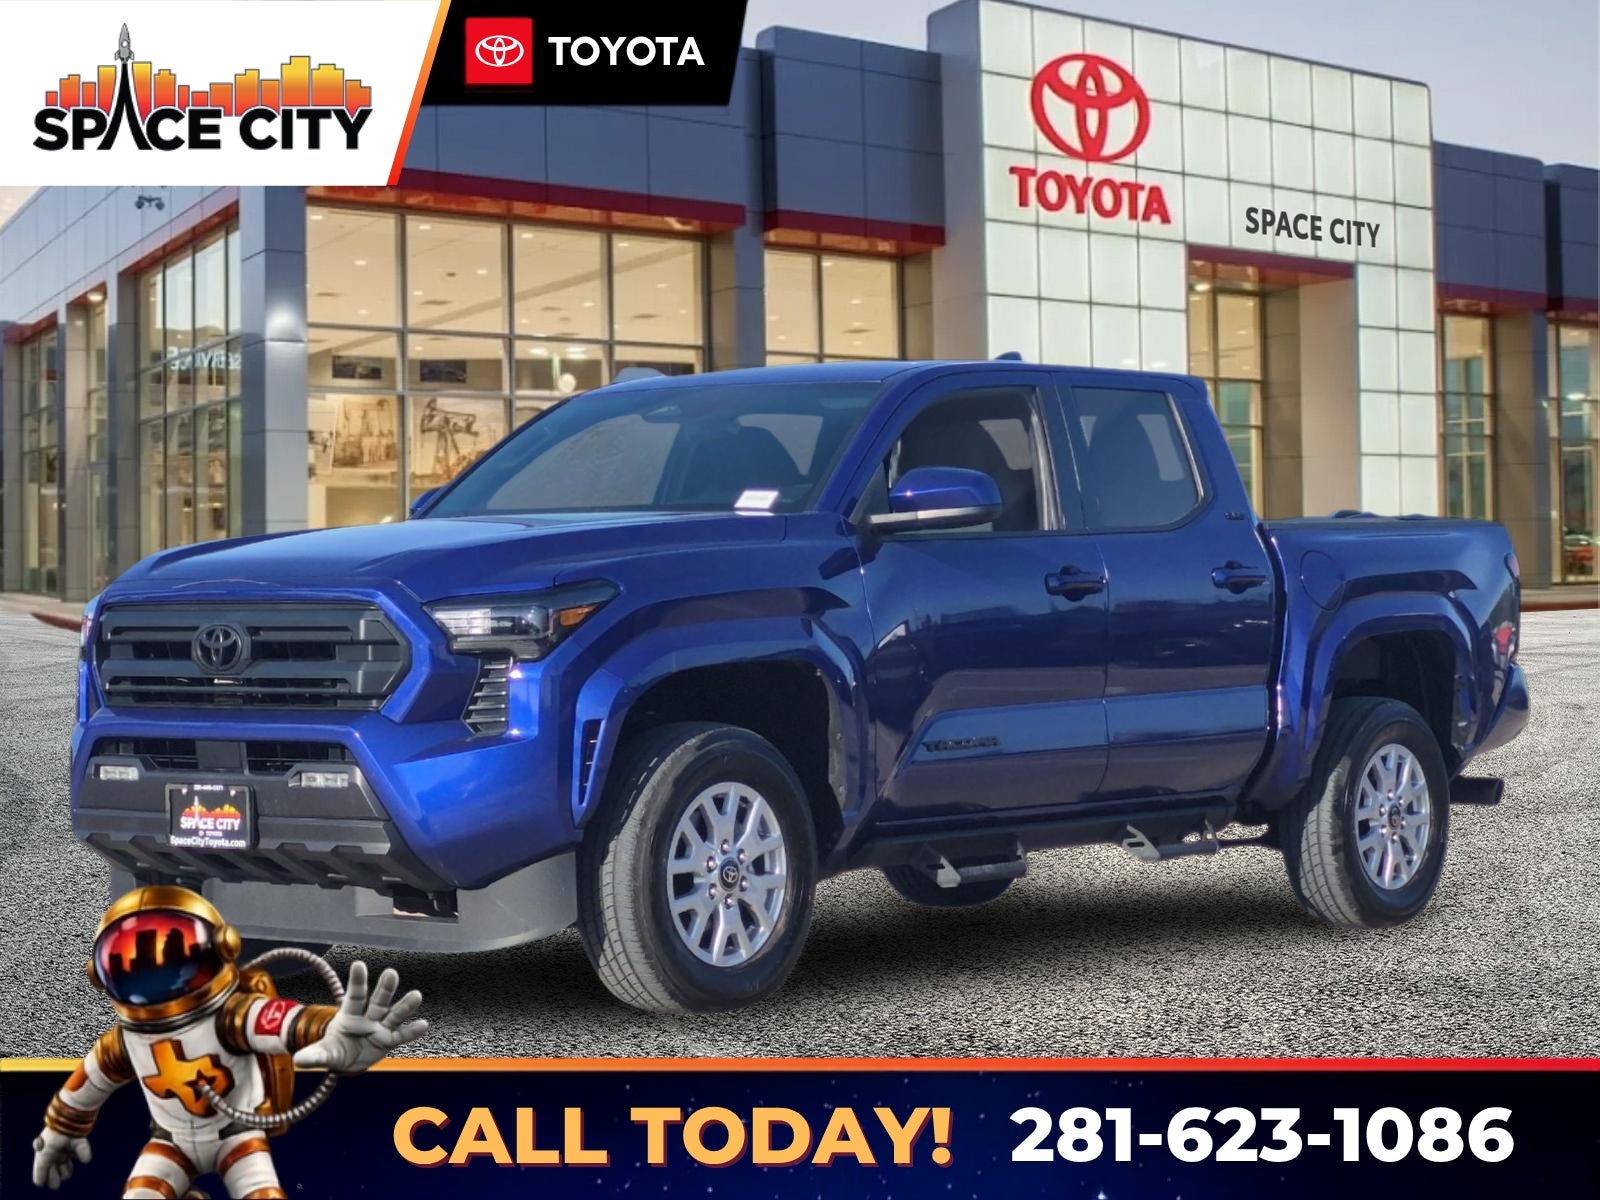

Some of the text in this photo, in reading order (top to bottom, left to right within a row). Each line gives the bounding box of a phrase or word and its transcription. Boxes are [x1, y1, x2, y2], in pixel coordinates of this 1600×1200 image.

[1009, 166, 1171, 225] TOYOTA
[1245, 206, 1380, 248] SPACE CITY
[180, 816, 241, 831] SPACE CITY
[170, 835, 246, 847] SpaceCityToyota.com
